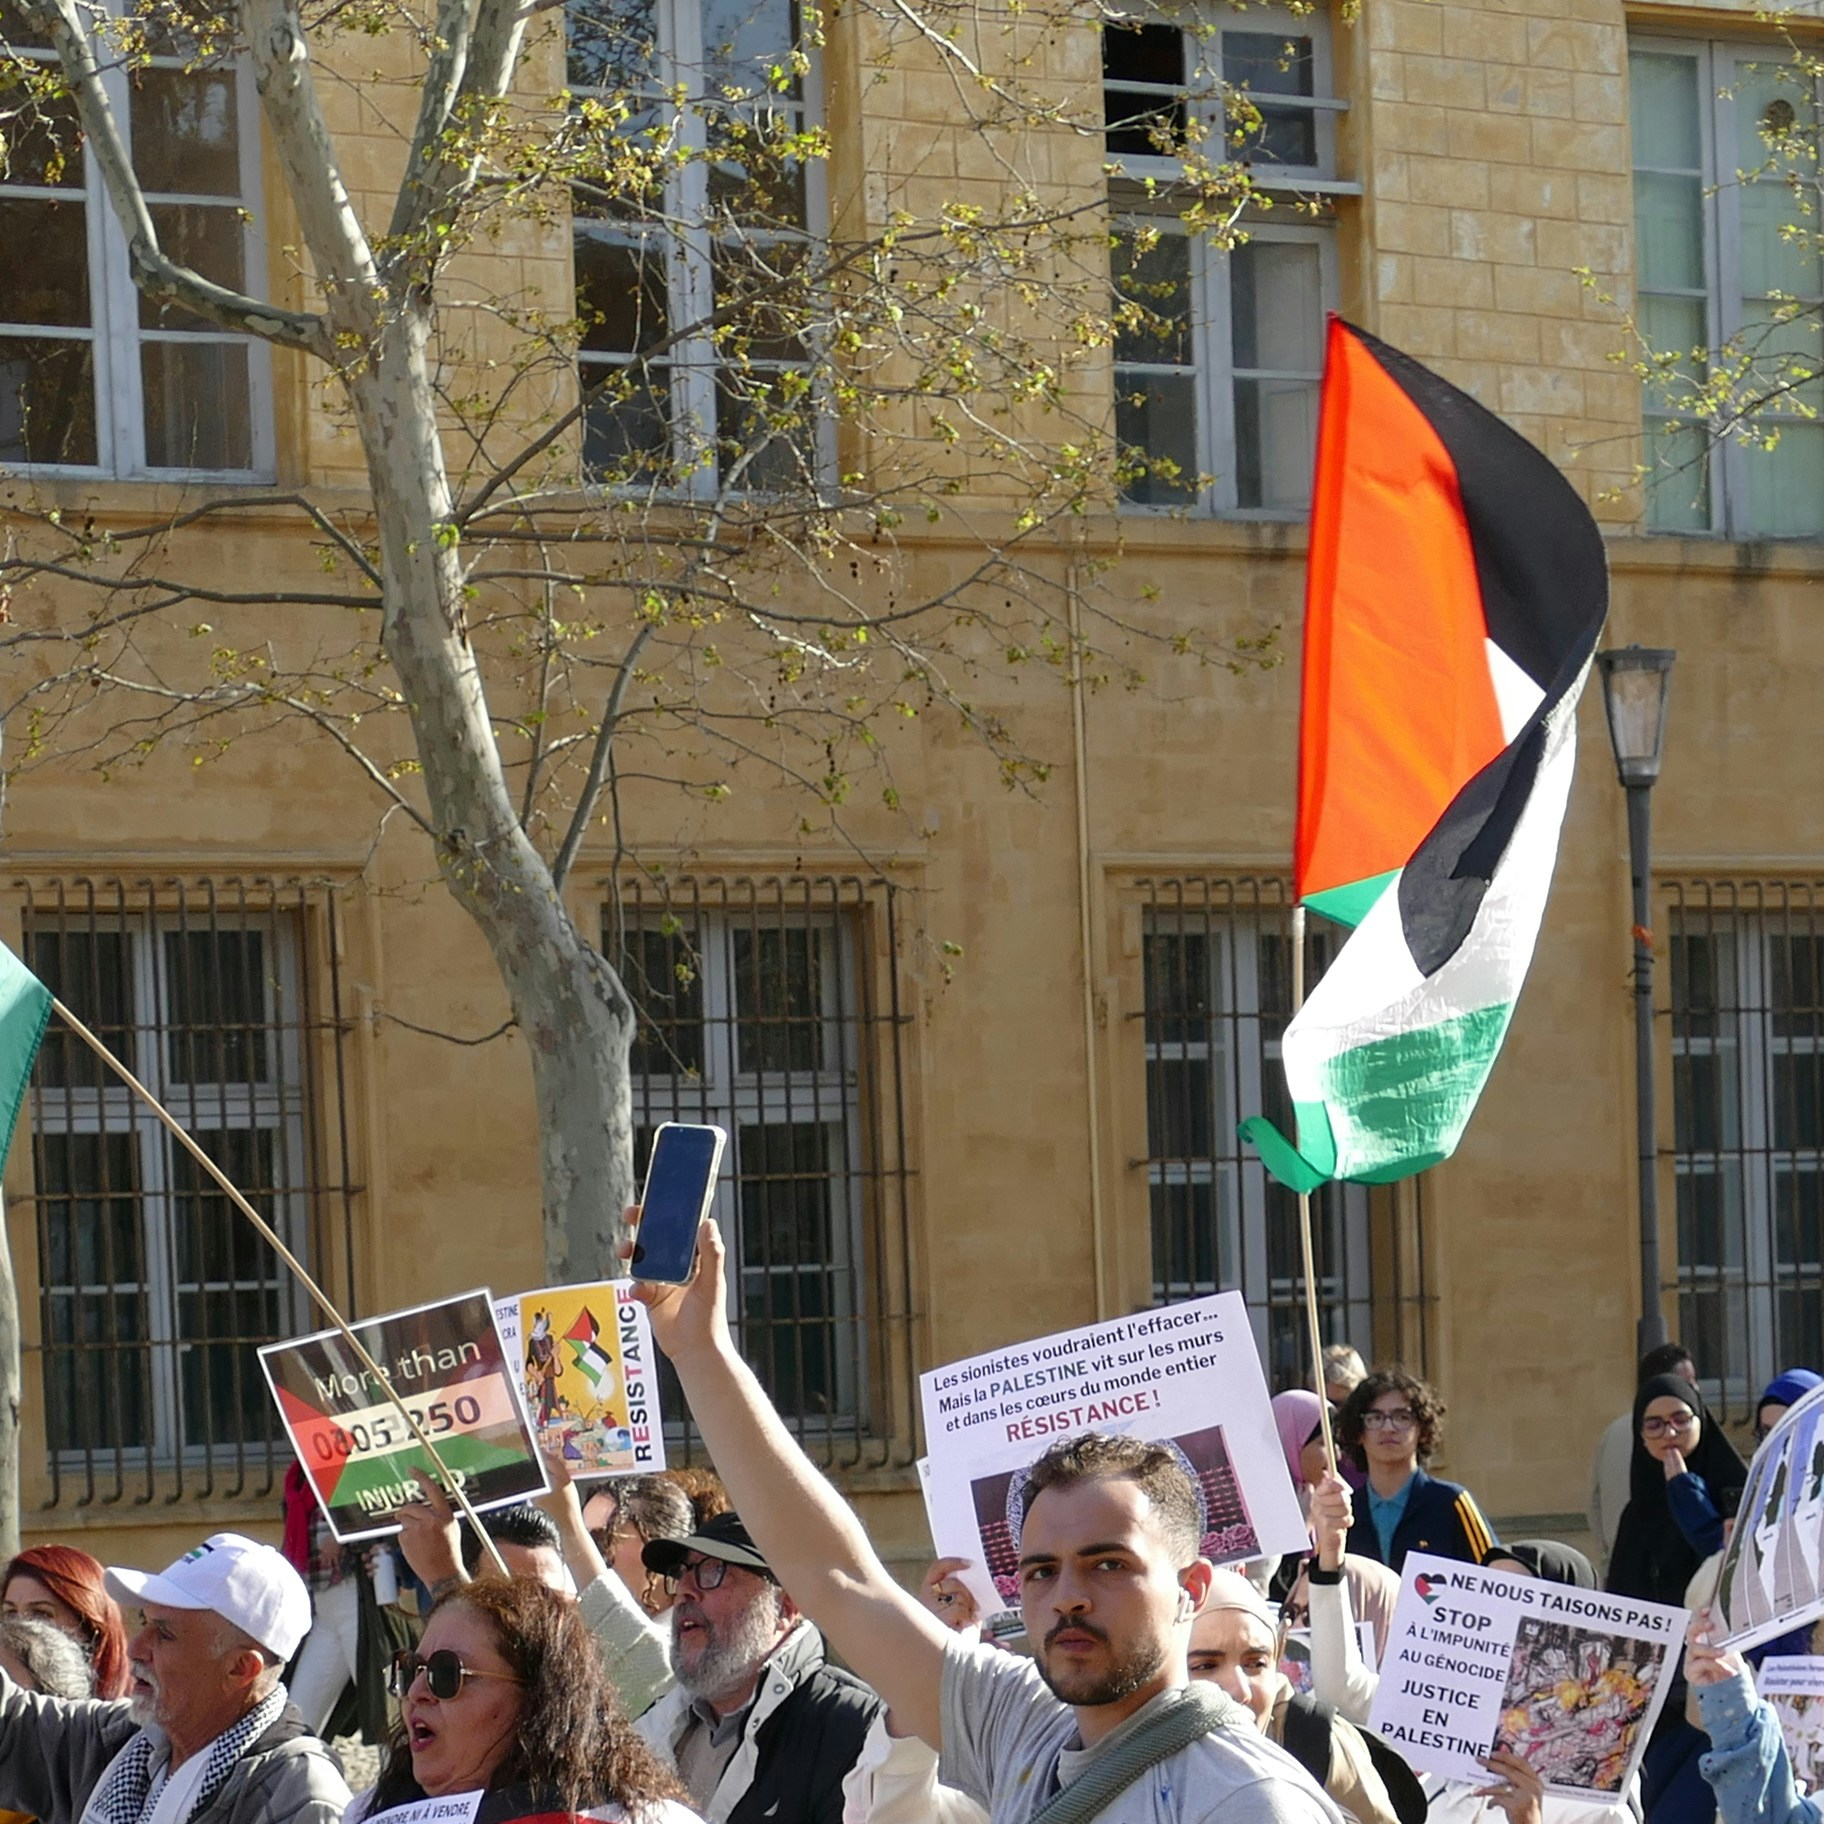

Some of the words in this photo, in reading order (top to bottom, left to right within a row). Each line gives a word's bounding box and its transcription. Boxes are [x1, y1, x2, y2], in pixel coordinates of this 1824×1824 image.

[312, 1365, 392, 1402] More
[397, 1341, 482, 1381] than
[616, 1288, 652, 1462] RESISTANCE
[933, 1375, 959, 1393] Les
[960, 1352, 1030, 1384] sionistes
[1032, 1327, 1125, 1363] voudraient
[939, 1392, 972, 1415] Mais
[974, 1388, 988, 1403] la
[990, 1360, 1089, 1398] PALESTINE
[1091, 1354, 1115, 1372] vit
[1118, 1349, 1146, 1366] sur
[1148, 1342, 1175, 1359] les
[1177, 1330, 1225, 1352] murs
[946, 1416, 961, 1432] et
[962, 1407, 998, 1428] dans
[1000, 1400, 1023, 1417] les
[1026, 1388, 1077, 1410] cœurs
[1080, 1380, 1101, 1397] du
[1103, 1367, 1162, 1392] monde
[1165, 1354, 1218, 1377] entier
[1006, 1391, 1150, 1443] RÉSISTANCE
[355, 1467, 466, 1512] INJURD
[1433, 1606, 1492, 1632] STOP
[1451, 1572, 1482, 1593] NE
[1480, 1579, 1536, 1605] NOUS
[1539, 1591, 1623, 1624] TAISONS
[1406, 1621, 1418, 1638] À
[1421, 1626, 1511, 1658] L'IMPUNITÉ
[1399, 1648, 1423, 1664] AU
[1424, 1653, 1506, 1683] GÉNOCIDE
[1401, 1679, 1482, 1710] JUSTICE
[1381, 1721, 1491, 1759] PALESTINE
[1422, 1708, 1450, 1728] EN
[431, 1801, 471, 1818] VENDRE,
